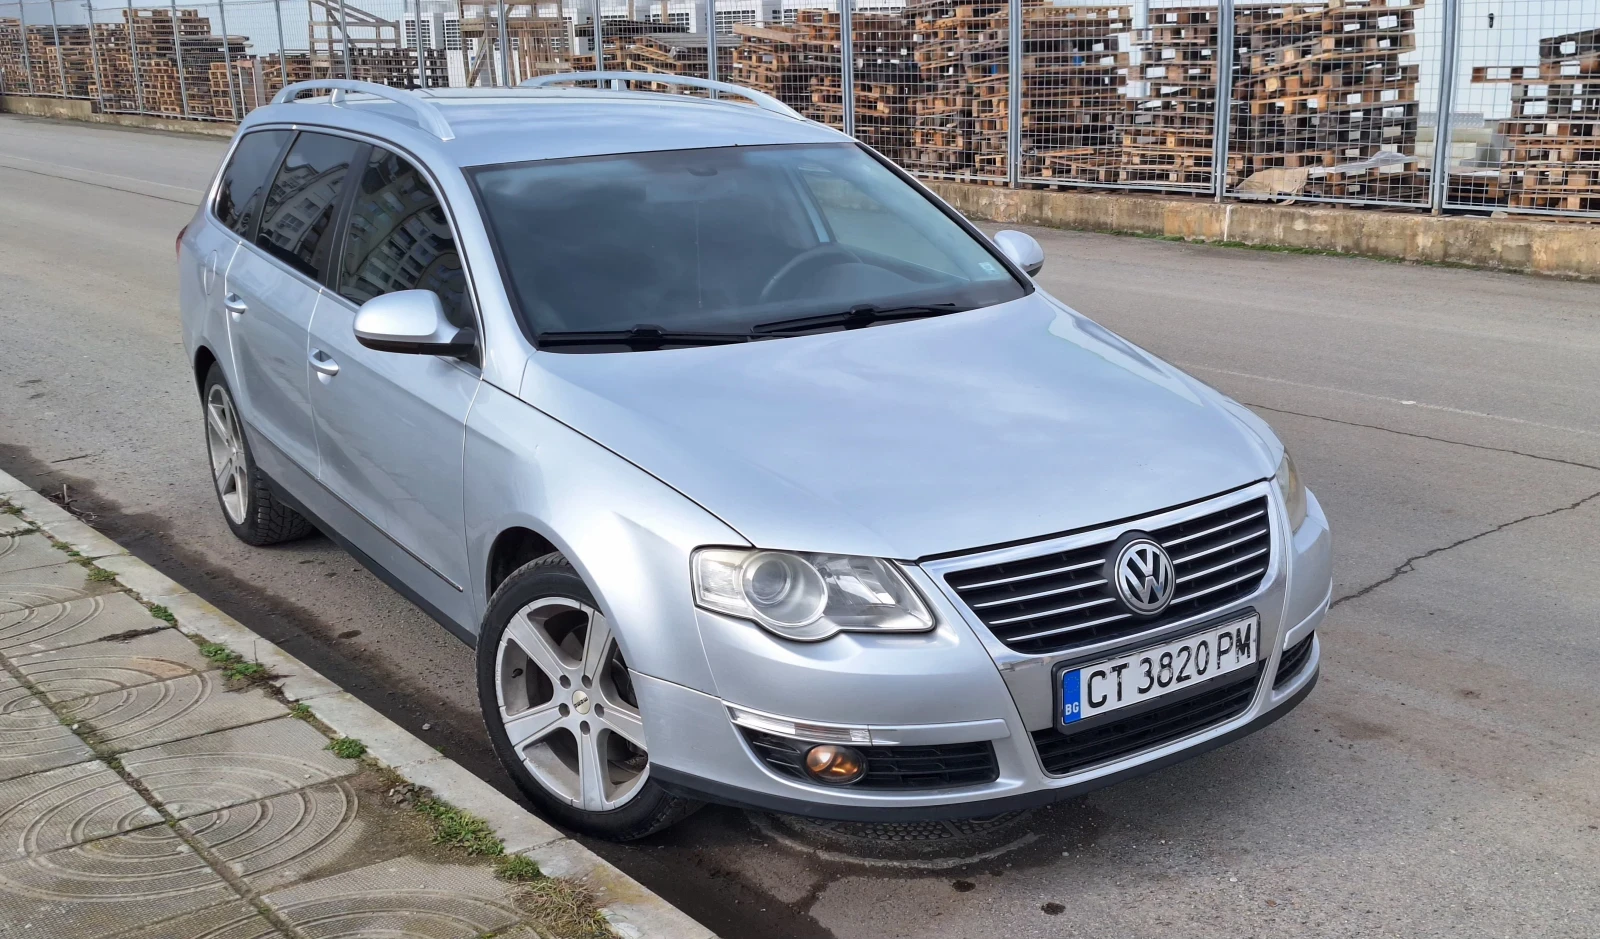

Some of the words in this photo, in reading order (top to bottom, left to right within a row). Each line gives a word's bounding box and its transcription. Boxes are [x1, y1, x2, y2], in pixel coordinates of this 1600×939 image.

[1118, 543, 1173, 610] VW
[1087, 662, 1130, 709] CT
[1137, 640, 1210, 694] 3820
[1216, 623, 1252, 670] PM
[1065, 701, 1079, 715] BG
